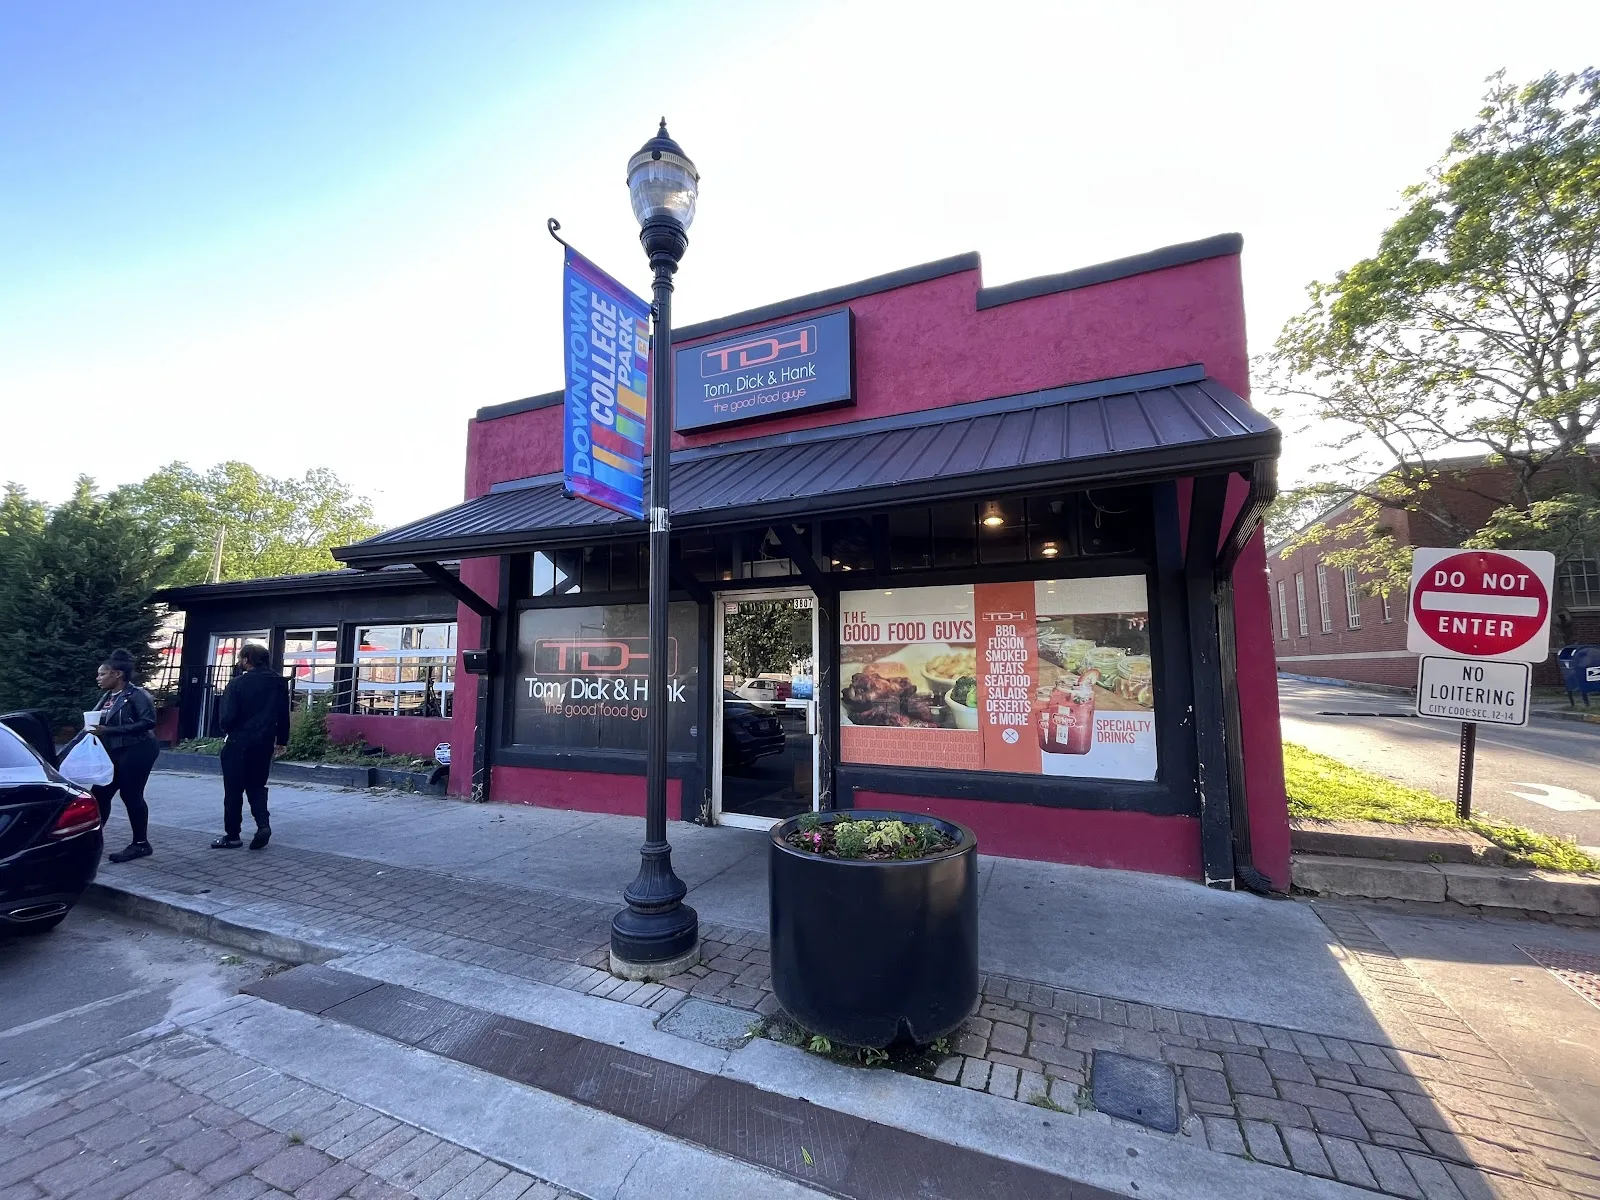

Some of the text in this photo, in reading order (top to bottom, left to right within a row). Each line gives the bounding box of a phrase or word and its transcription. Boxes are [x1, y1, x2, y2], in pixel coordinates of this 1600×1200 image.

[618, 308, 634, 388] PARK
[706, 330, 808, 371] TDH
[590, 292, 617, 426] COLLEGE
[570, 277, 591, 476] DOWNTOWN
[703, 361, 816, 398] Tom, Dick & Hank
[713, 387, 806, 413] the good food guys
[1434, 570, 1529, 591] DO NOT
[843, 611, 867, 623] THE
[843, 620, 973, 642] GOOD FOOD GUYS
[995, 624, 1016, 637] BBQ
[1438, 616, 1514, 638] ENTER
[988, 637, 1024, 649] FUSION
[543, 641, 649, 671] TD
[985, 649, 1028, 662] SMOKED
[990, 662, 1024, 674] MEATS
[1462, 665, 1484, 682] NO
[985, 674, 1031, 687] SEAFOOD
[525, 678, 686, 703] Tom, Dick & Hnk
[988, 687, 1028, 700] SALADS
[1430, 684, 1515, 707] LOITERING
[545, 703, 648, 721] the good food gu
[986, 700, 1031, 713] DESERTS
[1428, 704, 1447, 715] CITY
[1492, 710, 1514, 721] 12-14
[989, 712, 997, 725] &
[999, 712, 1029, 725] MORE
[1096, 719, 1151, 732] SPECIALTY
[1097, 731, 1135, 744] DRINKS
